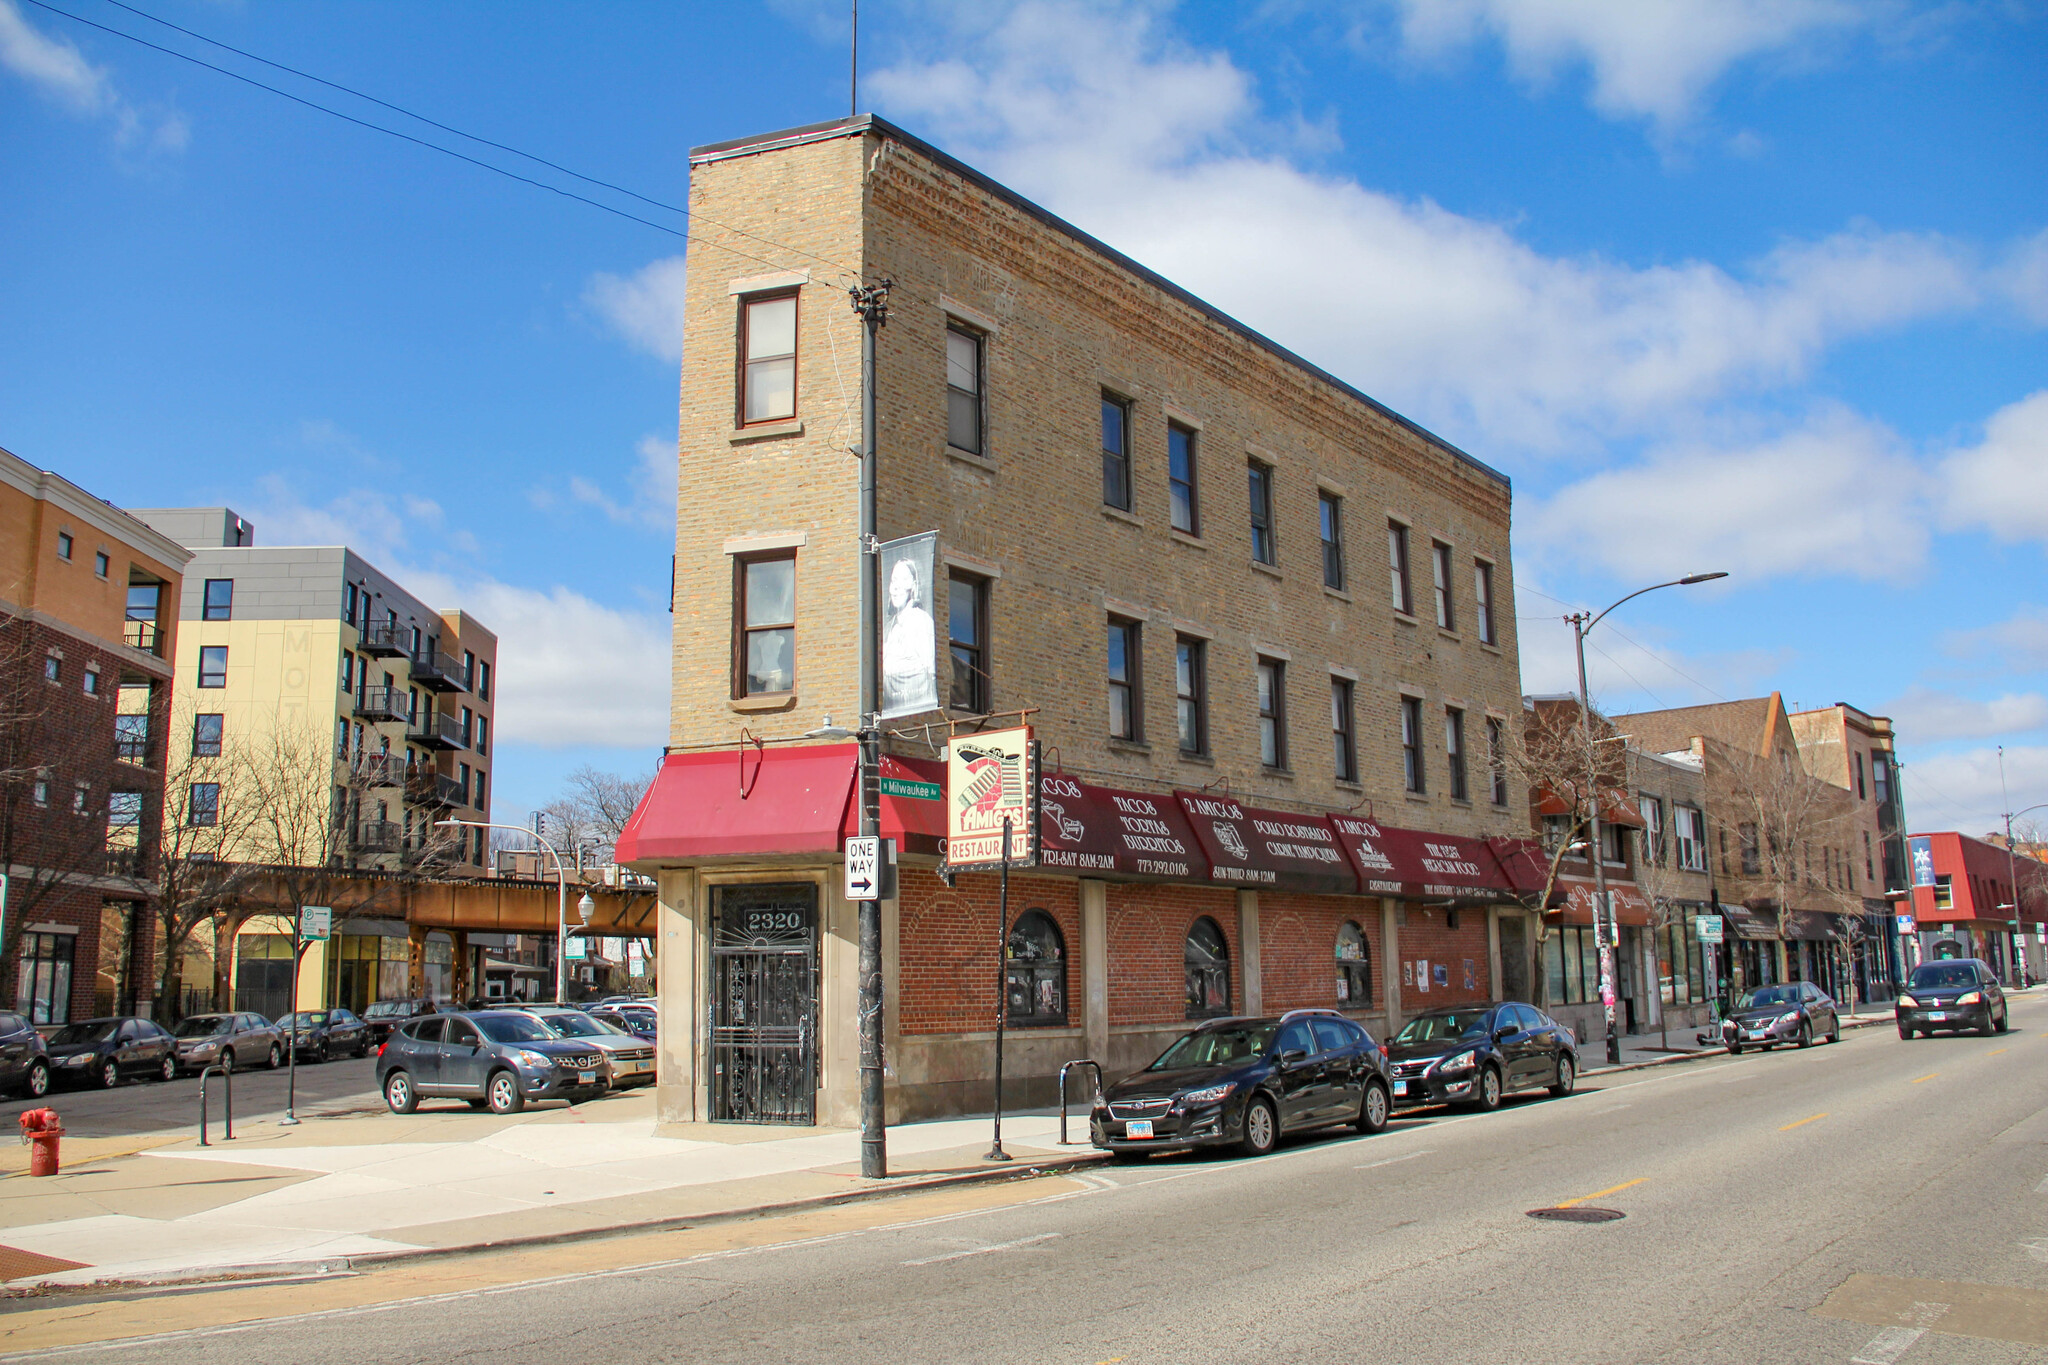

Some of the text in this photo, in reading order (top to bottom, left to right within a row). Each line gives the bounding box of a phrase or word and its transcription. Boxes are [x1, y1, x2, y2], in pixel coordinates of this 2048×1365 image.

[883, 782, 888, 790] N
[889, 781, 929, 797] Milwaukee
[1113, 796, 1157, 815] TACOS
[1184, 798, 1243, 820] 2 AMIGOS
[963, 807, 1022, 831] AMIGOS
[1120, 816, 1170, 835] TORTAS
[1253, 820, 1285, 836] POLLO
[1334, 819, 1381, 837] 2 AMIGOS
[850, 842, 873, 857] ONE
[1122, 834, 1185, 854] BURRITOS
[1424, 843, 1443, 857] THE
[850, 859, 874, 873] WAY
[1042, 850, 1115, 869] FRI-SAT 8AM-2AM
[1137, 859, 1188, 875] 773.292.0106
[1422, 858, 1457, 874] MEXICAN
[1213, 865, 1275, 883] SUN-THUR 8AM-12AM
[749, 912, 800, 929] 2320
